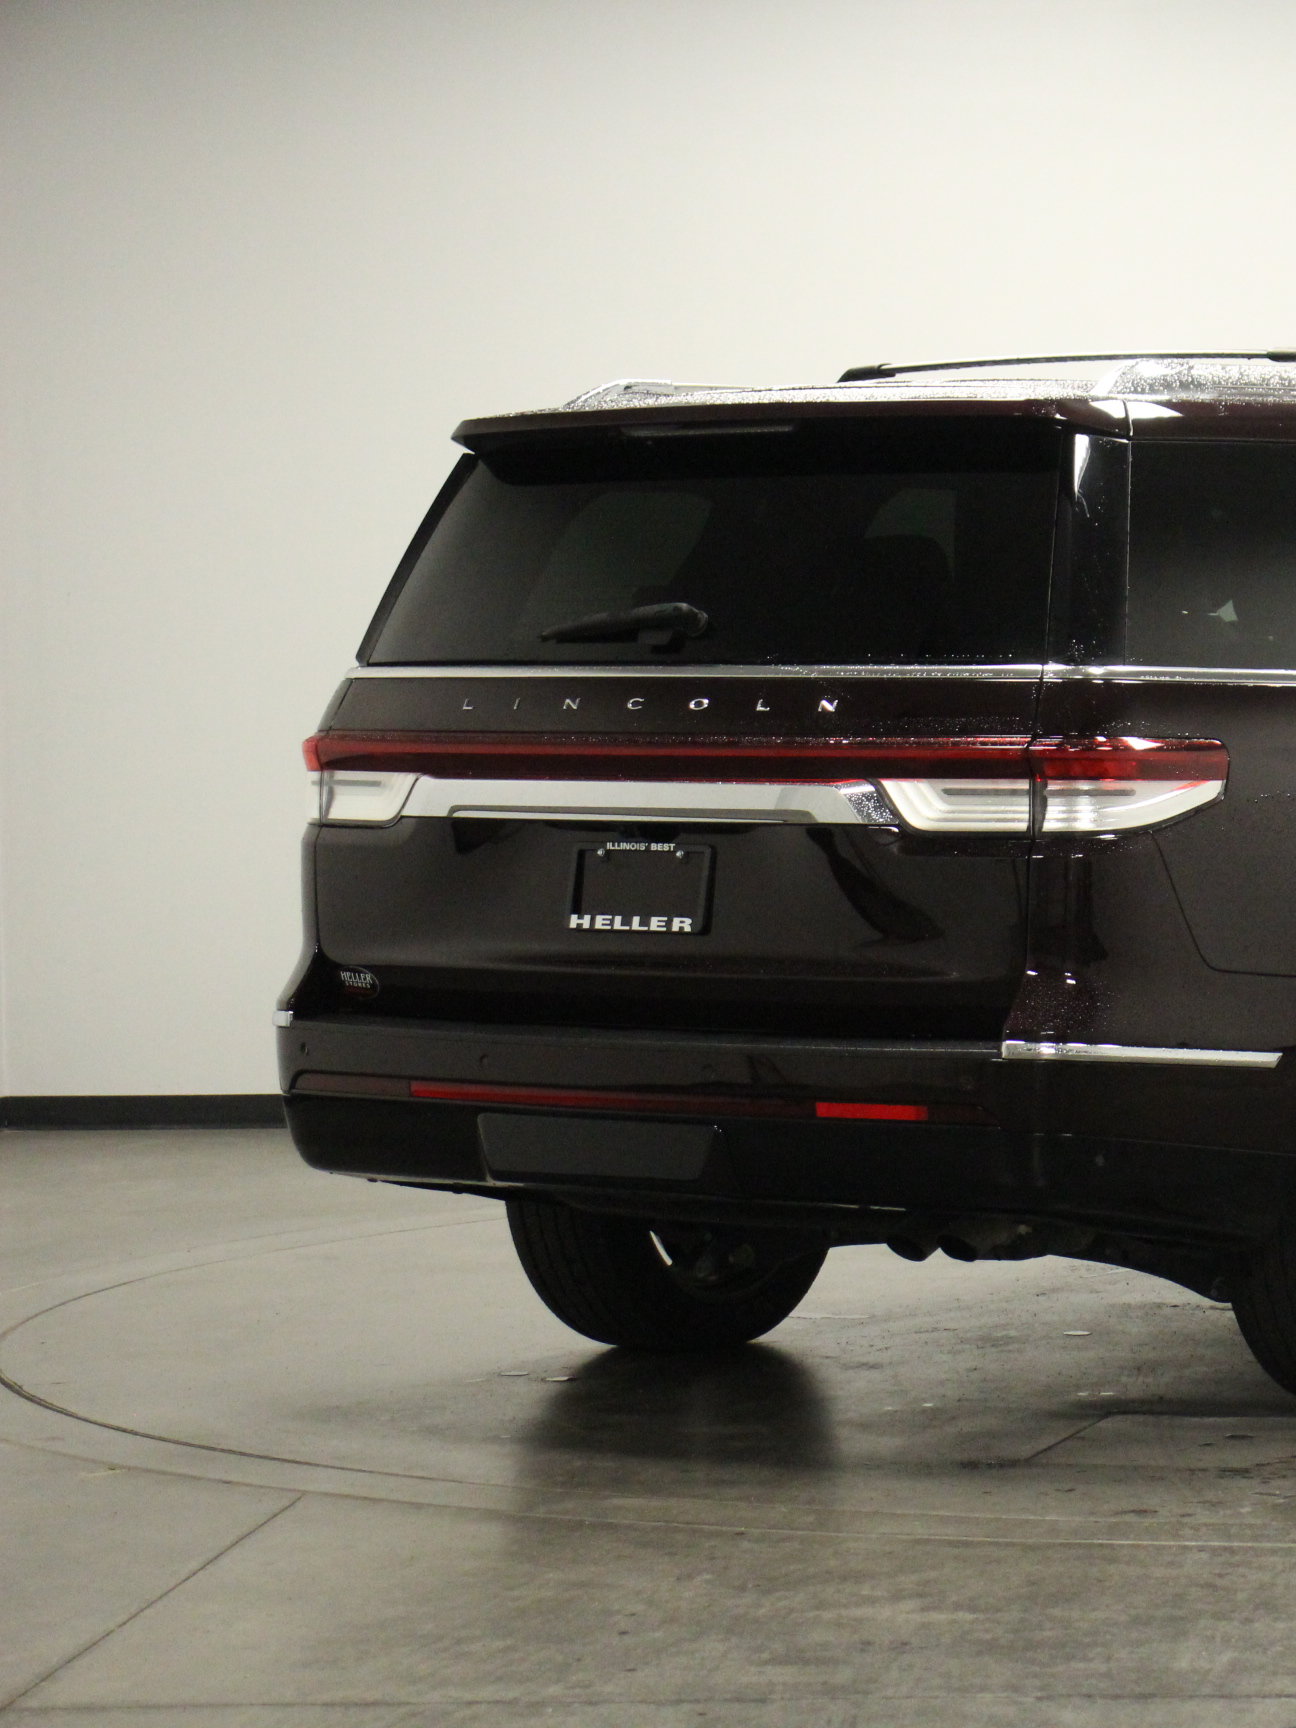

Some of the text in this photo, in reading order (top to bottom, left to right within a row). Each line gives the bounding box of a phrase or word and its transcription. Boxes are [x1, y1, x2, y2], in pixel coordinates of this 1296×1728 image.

[462, 698, 838, 712] LINCOLN
[606, 841, 676, 852] ILLINOIS' BEST
[569, 914, 692, 932] HELLER
[340, 971, 373, 984] HELLER
